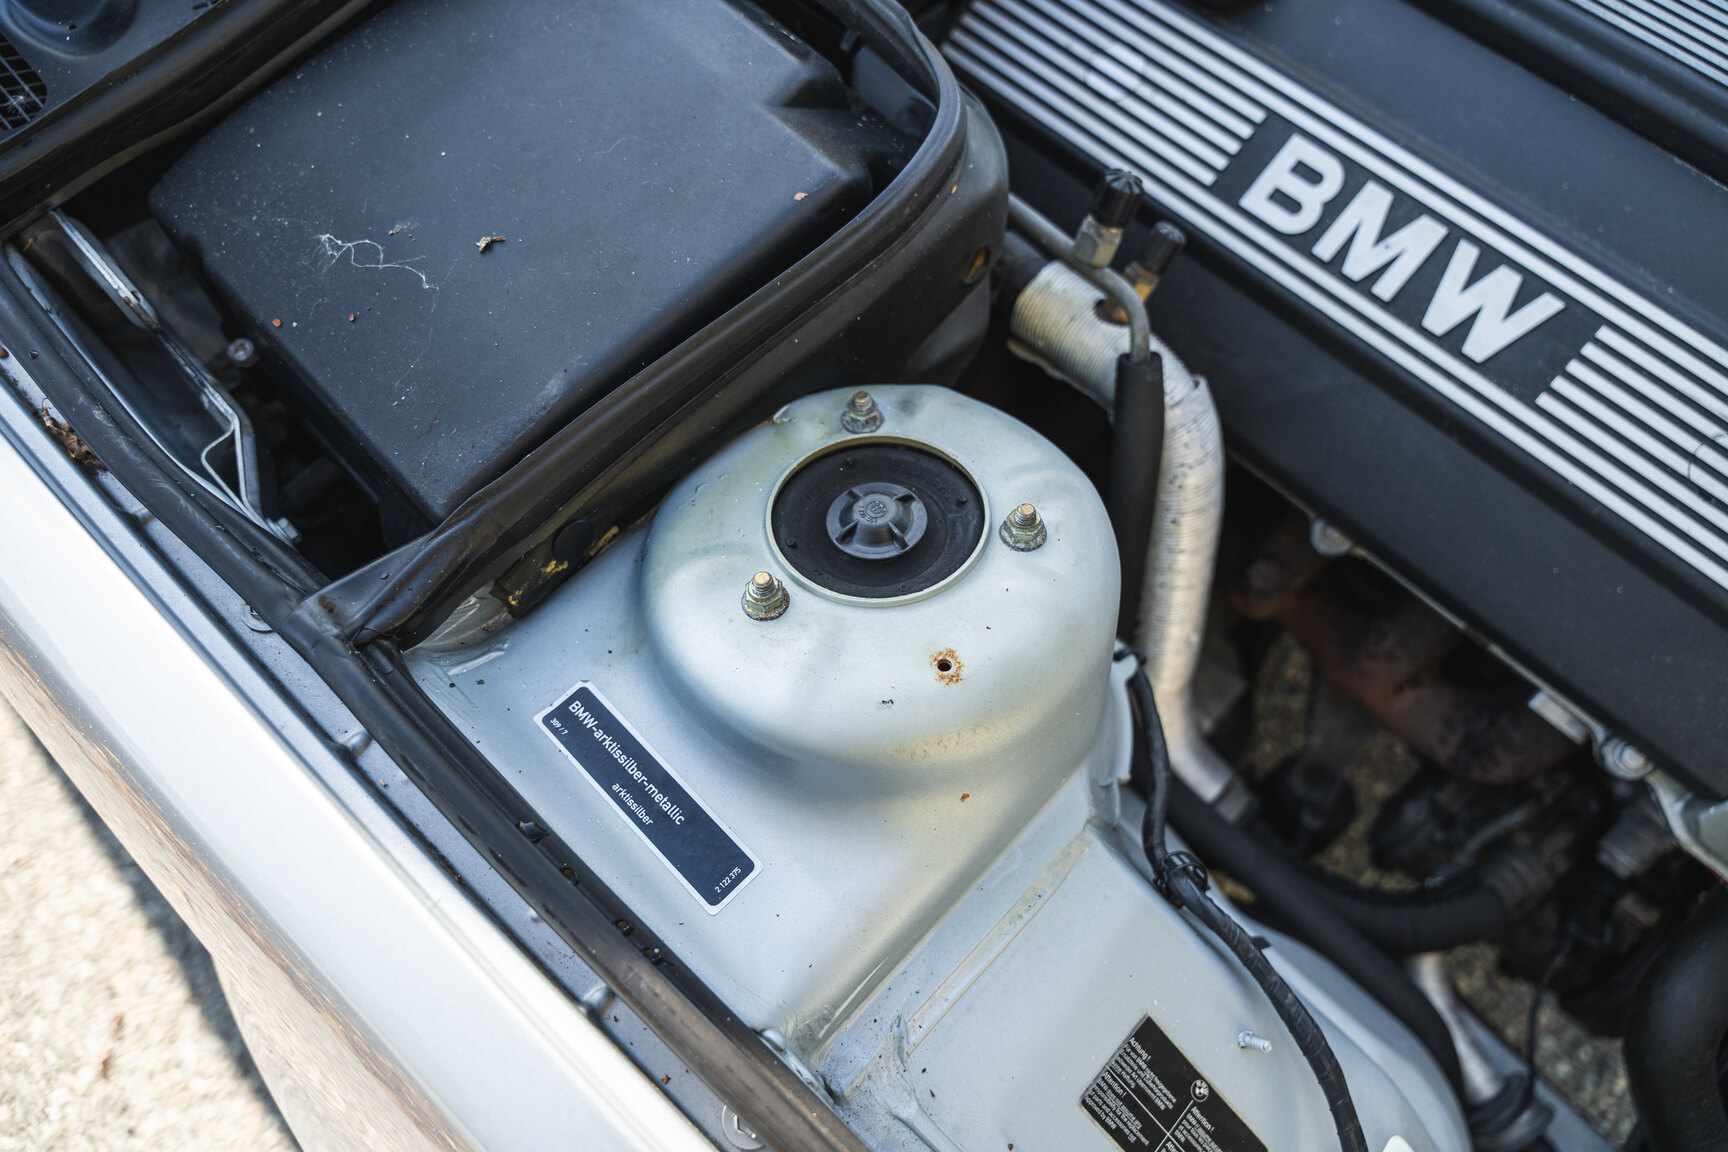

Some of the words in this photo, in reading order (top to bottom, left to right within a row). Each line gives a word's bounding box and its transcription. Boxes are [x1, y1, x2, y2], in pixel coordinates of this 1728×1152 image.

[1238, 133, 1566, 364] BMW
[550, 717, 560, 728] 309
[568, 700, 685, 825] BMW-arktissilber-metallic
[612, 782, 654, 826] arktissilber
[720, 876, 732, 889] 122
[729, 866, 742, 878] 375
[1129, 1038, 1149, 1060] Achtung
[1136, 1057, 1147, 1069] BMW
[1104, 1071, 1124, 1095] Attention
[1117, 1056, 1133, 1074] edweder
[1154, 1098, 1166, 1110] BMW
[1187, 1113, 1197, 1126] BMW
[1192, 1106, 1212, 1130] Attention
